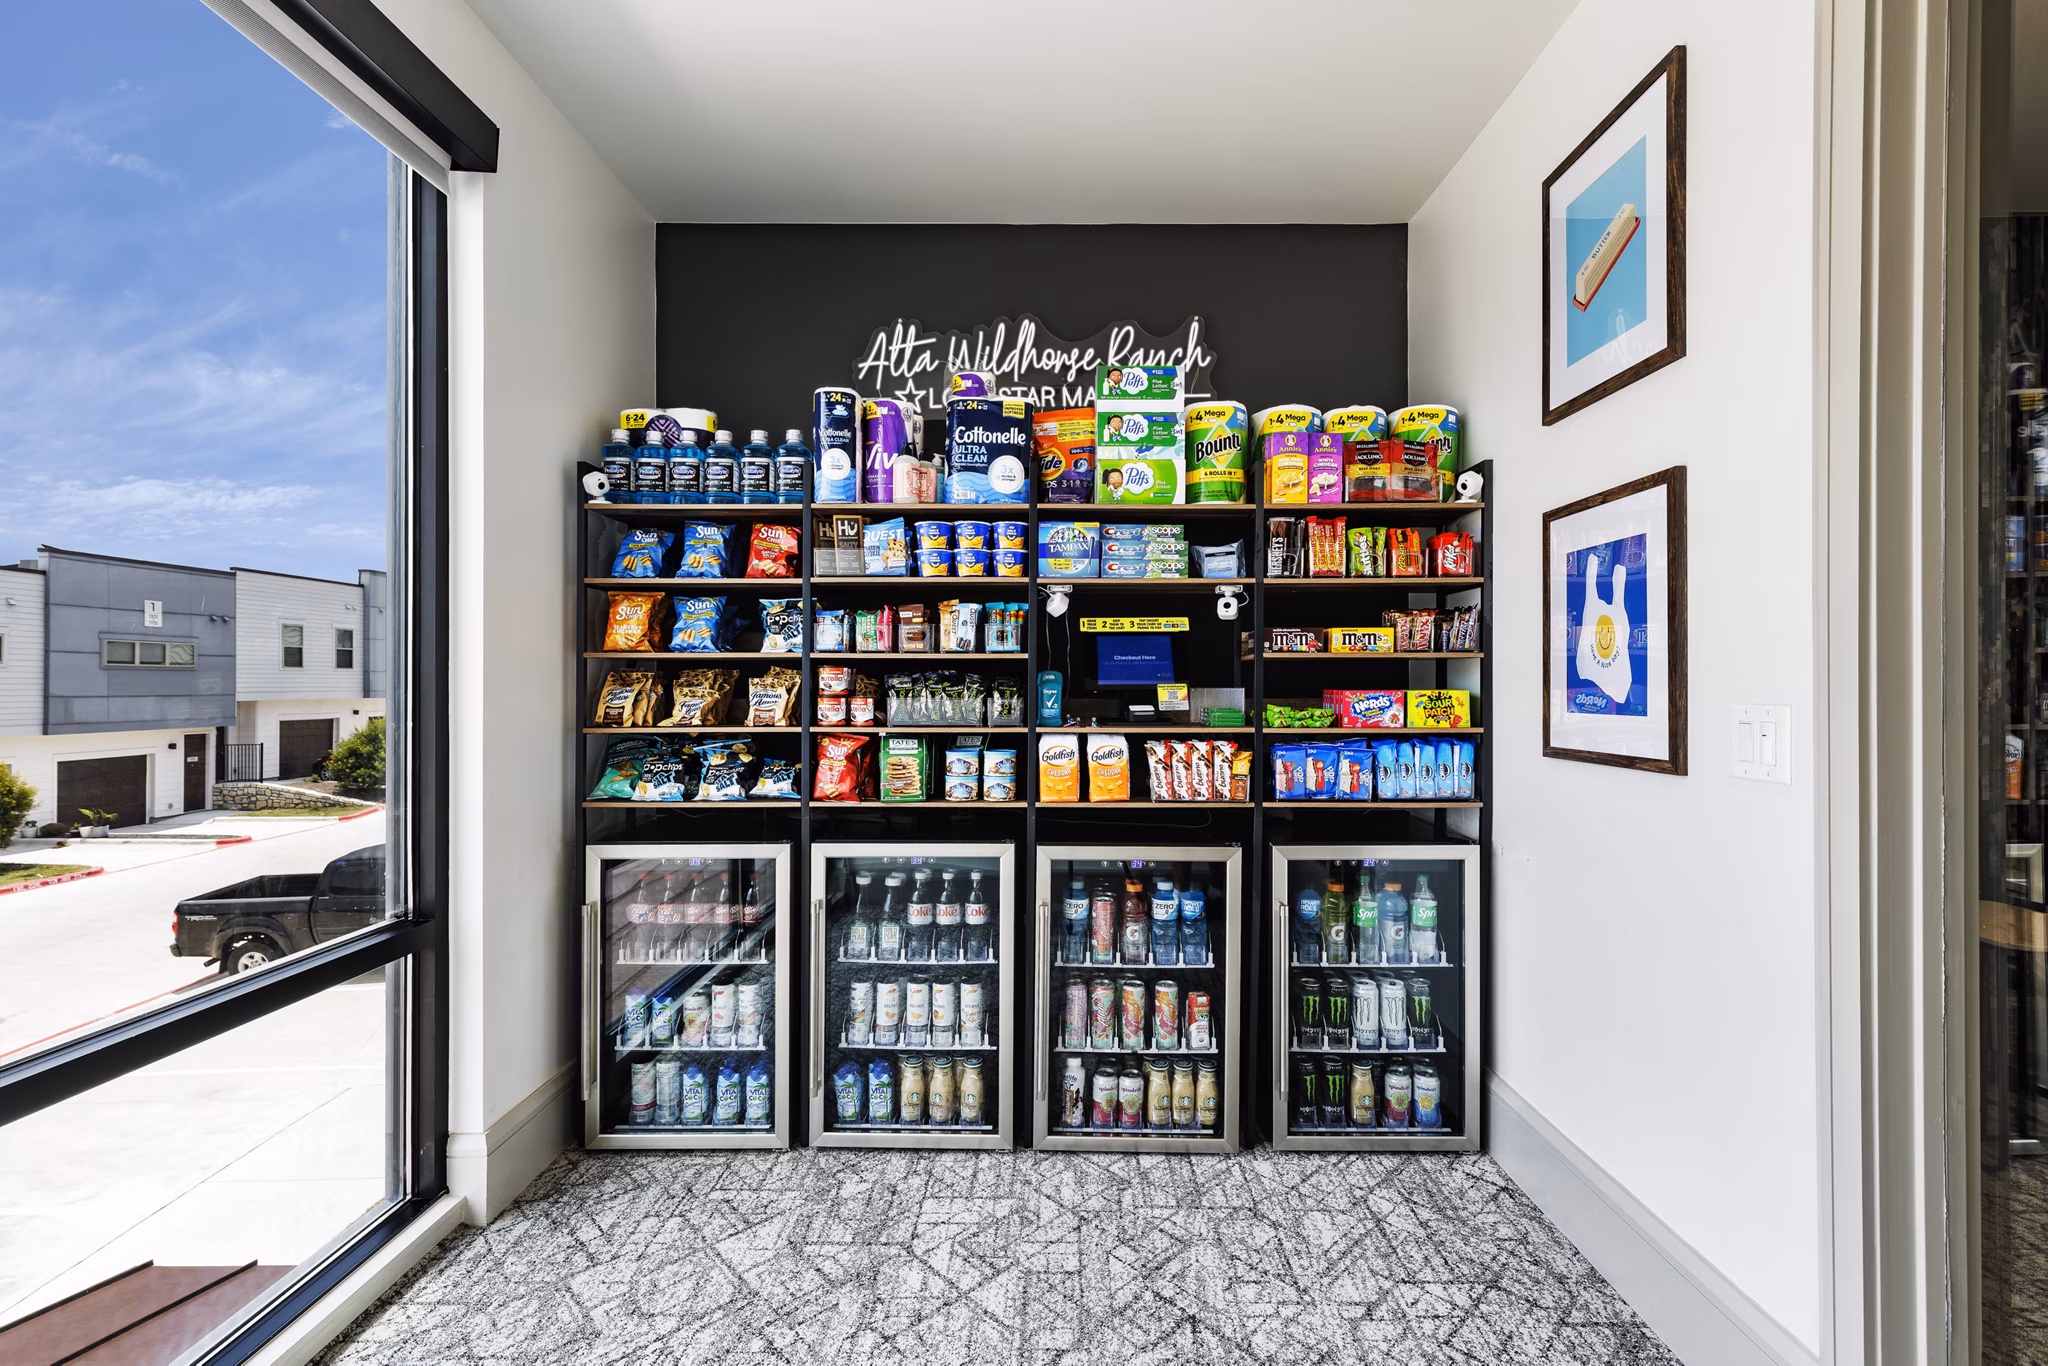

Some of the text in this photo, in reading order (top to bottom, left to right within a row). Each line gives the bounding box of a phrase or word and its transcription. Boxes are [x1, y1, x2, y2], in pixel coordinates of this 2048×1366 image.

[1591, 230, 1612, 259] BUTTER
[950, 320, 1101, 382] Wildhorse
[1104, 321, 1212, 372] Ranch
[1123, 371, 1144, 388] Puffs
[830, 393, 841, 402] 24
[998, 387, 1056, 408] STAR
[966, 400, 979, 410] 24
[1204, 410, 1226, 418] Mega
[1285, 413, 1306, 423] Mega
[1347, 415, 1368, 423] Mega
[1417, 412, 1439, 421] Mega
[1124, 418, 1145, 435] Puffs
[821, 428, 853, 440] Cottonelle
[955, 426, 1027, 445] Cottonelle
[956, 445, 988, 454] ULTRA
[1194, 432, 1242, 464] Bounty
[830, 456, 841, 464] 3x
[956, 454, 988, 463] CLEAN
[1001, 464, 1014, 474] 3x
[1126, 468, 1149, 486] Puffs
[634, 529, 658, 542] Sun
[695, 525, 719, 539] Sun
[758, 526, 784, 540] Sun
[863, 529, 904, 541] QUEST
[1103, 526, 1182, 537] Crest scope
[838, 541, 859, 549] SALTY
[1048, 543, 1089, 553] TAMPAX
[1107, 542, 1186, 553] Crest scope
[1271, 536, 1283, 576] HERSHEY'S
[1359, 535, 1373, 576] Skittles
[1397, 543, 1406, 572] Reese's
[1107, 561, 1186, 572] Crest scope
[150, 602, 155, 612] 1
[686, 600, 711, 612] Sun
[615, 605, 641, 620] Sun
[1101, 620, 1108, 628] 2
[1129, 620, 1135, 628] 3
[780, 625, 794, 636] SEA
[782, 629, 801, 642] SALT
[1399, 619, 1410, 650] TWIX
[1418, 618, 1431, 650] TWIX
[1272, 632, 1316, 646] m&m's
[1341, 632, 1383, 646] m&m's
[1600, 661, 1612, 669] Nice
[819, 675, 843, 683] nutella
[607, 687, 636, 698] Famous
[750, 689, 783, 701] Famous
[751, 698, 778, 708] Amos
[1425, 699, 1453, 709] SOUR
[819, 706, 841, 714] nutella
[1424, 707, 1455, 718] PATCH
[826, 745, 848, 758] Sun
[1041, 748, 1076, 763] Goldfish
[1091, 747, 1124, 763] Goldfish
[643, 763, 683, 773] popchips
[1046, 767, 1073, 777] CHEDDAR
[1096, 767, 1123, 776] CHEDDAR
[654, 773, 676, 790] SALT
[1155, 765, 1163, 789] bueno
[1176, 765, 1184, 789] bueno
[1196, 764, 1204, 787] bueno
[717, 775, 738, 792] SALT
[908, 905, 932, 917] Coke
[965, 905, 988, 918] Coke
[719, 1088, 737, 1096] VITA
